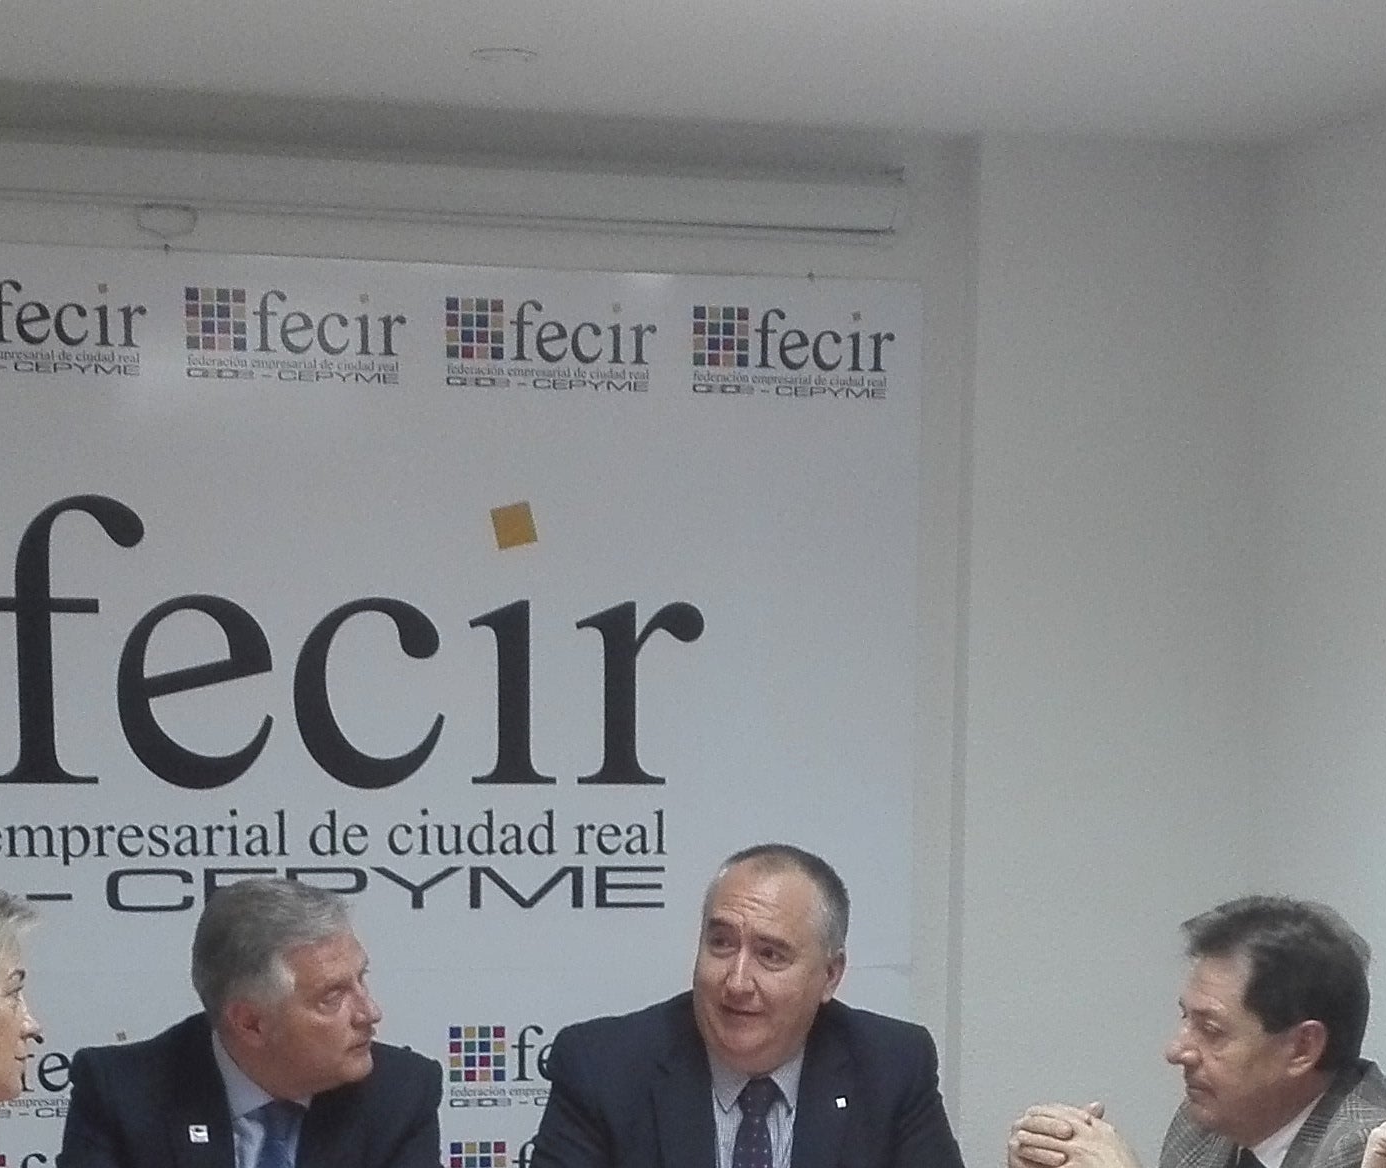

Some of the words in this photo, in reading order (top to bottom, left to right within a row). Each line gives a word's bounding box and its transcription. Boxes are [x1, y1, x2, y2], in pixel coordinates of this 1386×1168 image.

[253, 289, 407, 356] fecir
[510, 299, 657, 365] fecir
[755, 308, 895, 372] fecir
[309, 808, 369, 857] de
[387, 808, 558, 857] ciudad
[574, 808, 668, 857] real
[509, 1087, 550, 1100] empres
